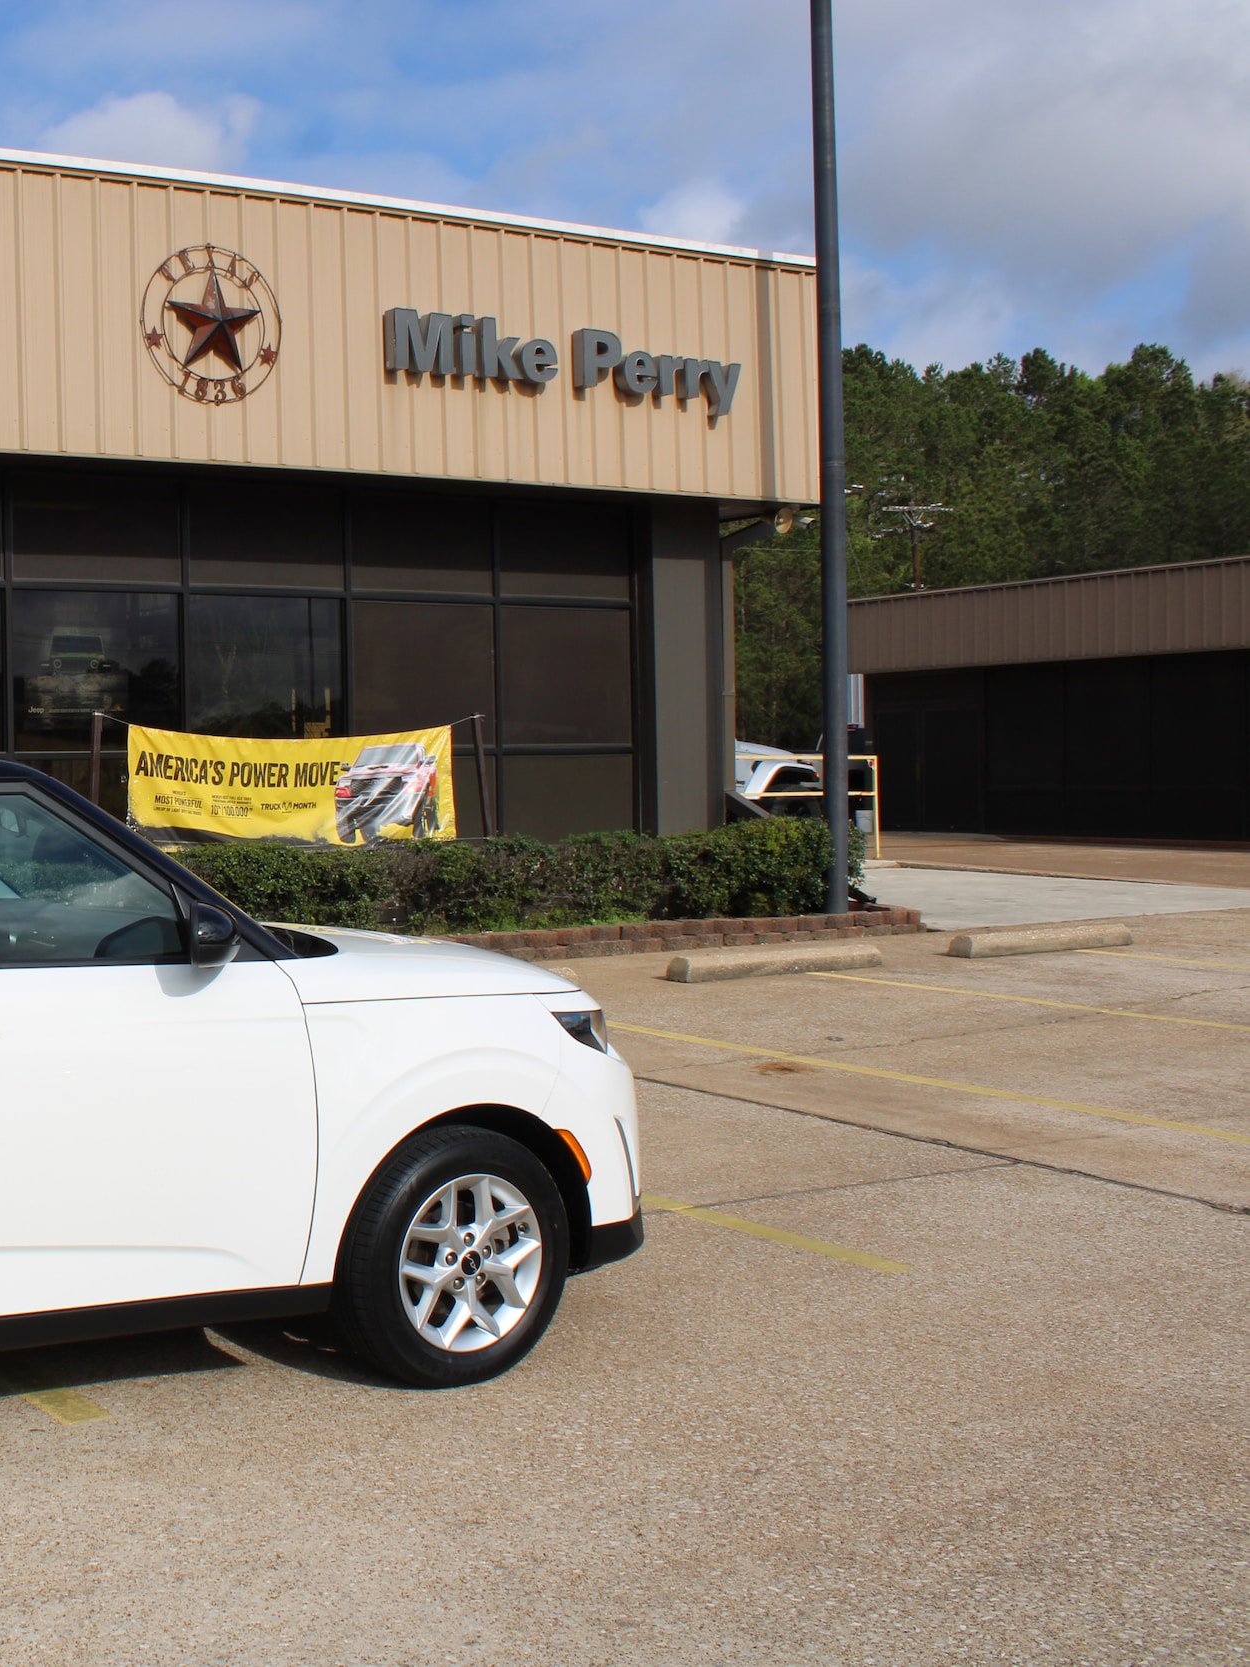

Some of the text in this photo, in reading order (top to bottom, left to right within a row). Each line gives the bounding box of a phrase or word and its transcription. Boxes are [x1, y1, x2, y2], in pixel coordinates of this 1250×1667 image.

[157, 245, 261, 288] TEXAS
[384, 307, 741, 416] Mike Perry
[176, 371, 247, 401] 1836
[28, 706, 44, 714] Jeep
[135, 750, 226, 786] AMERICA'S
[228, 762, 289, 788] POWER
[154, 794, 173, 805] MOST
[174, 797, 203, 809] POWERFUL
[261, 802, 317, 811] TRUCK MONTH
